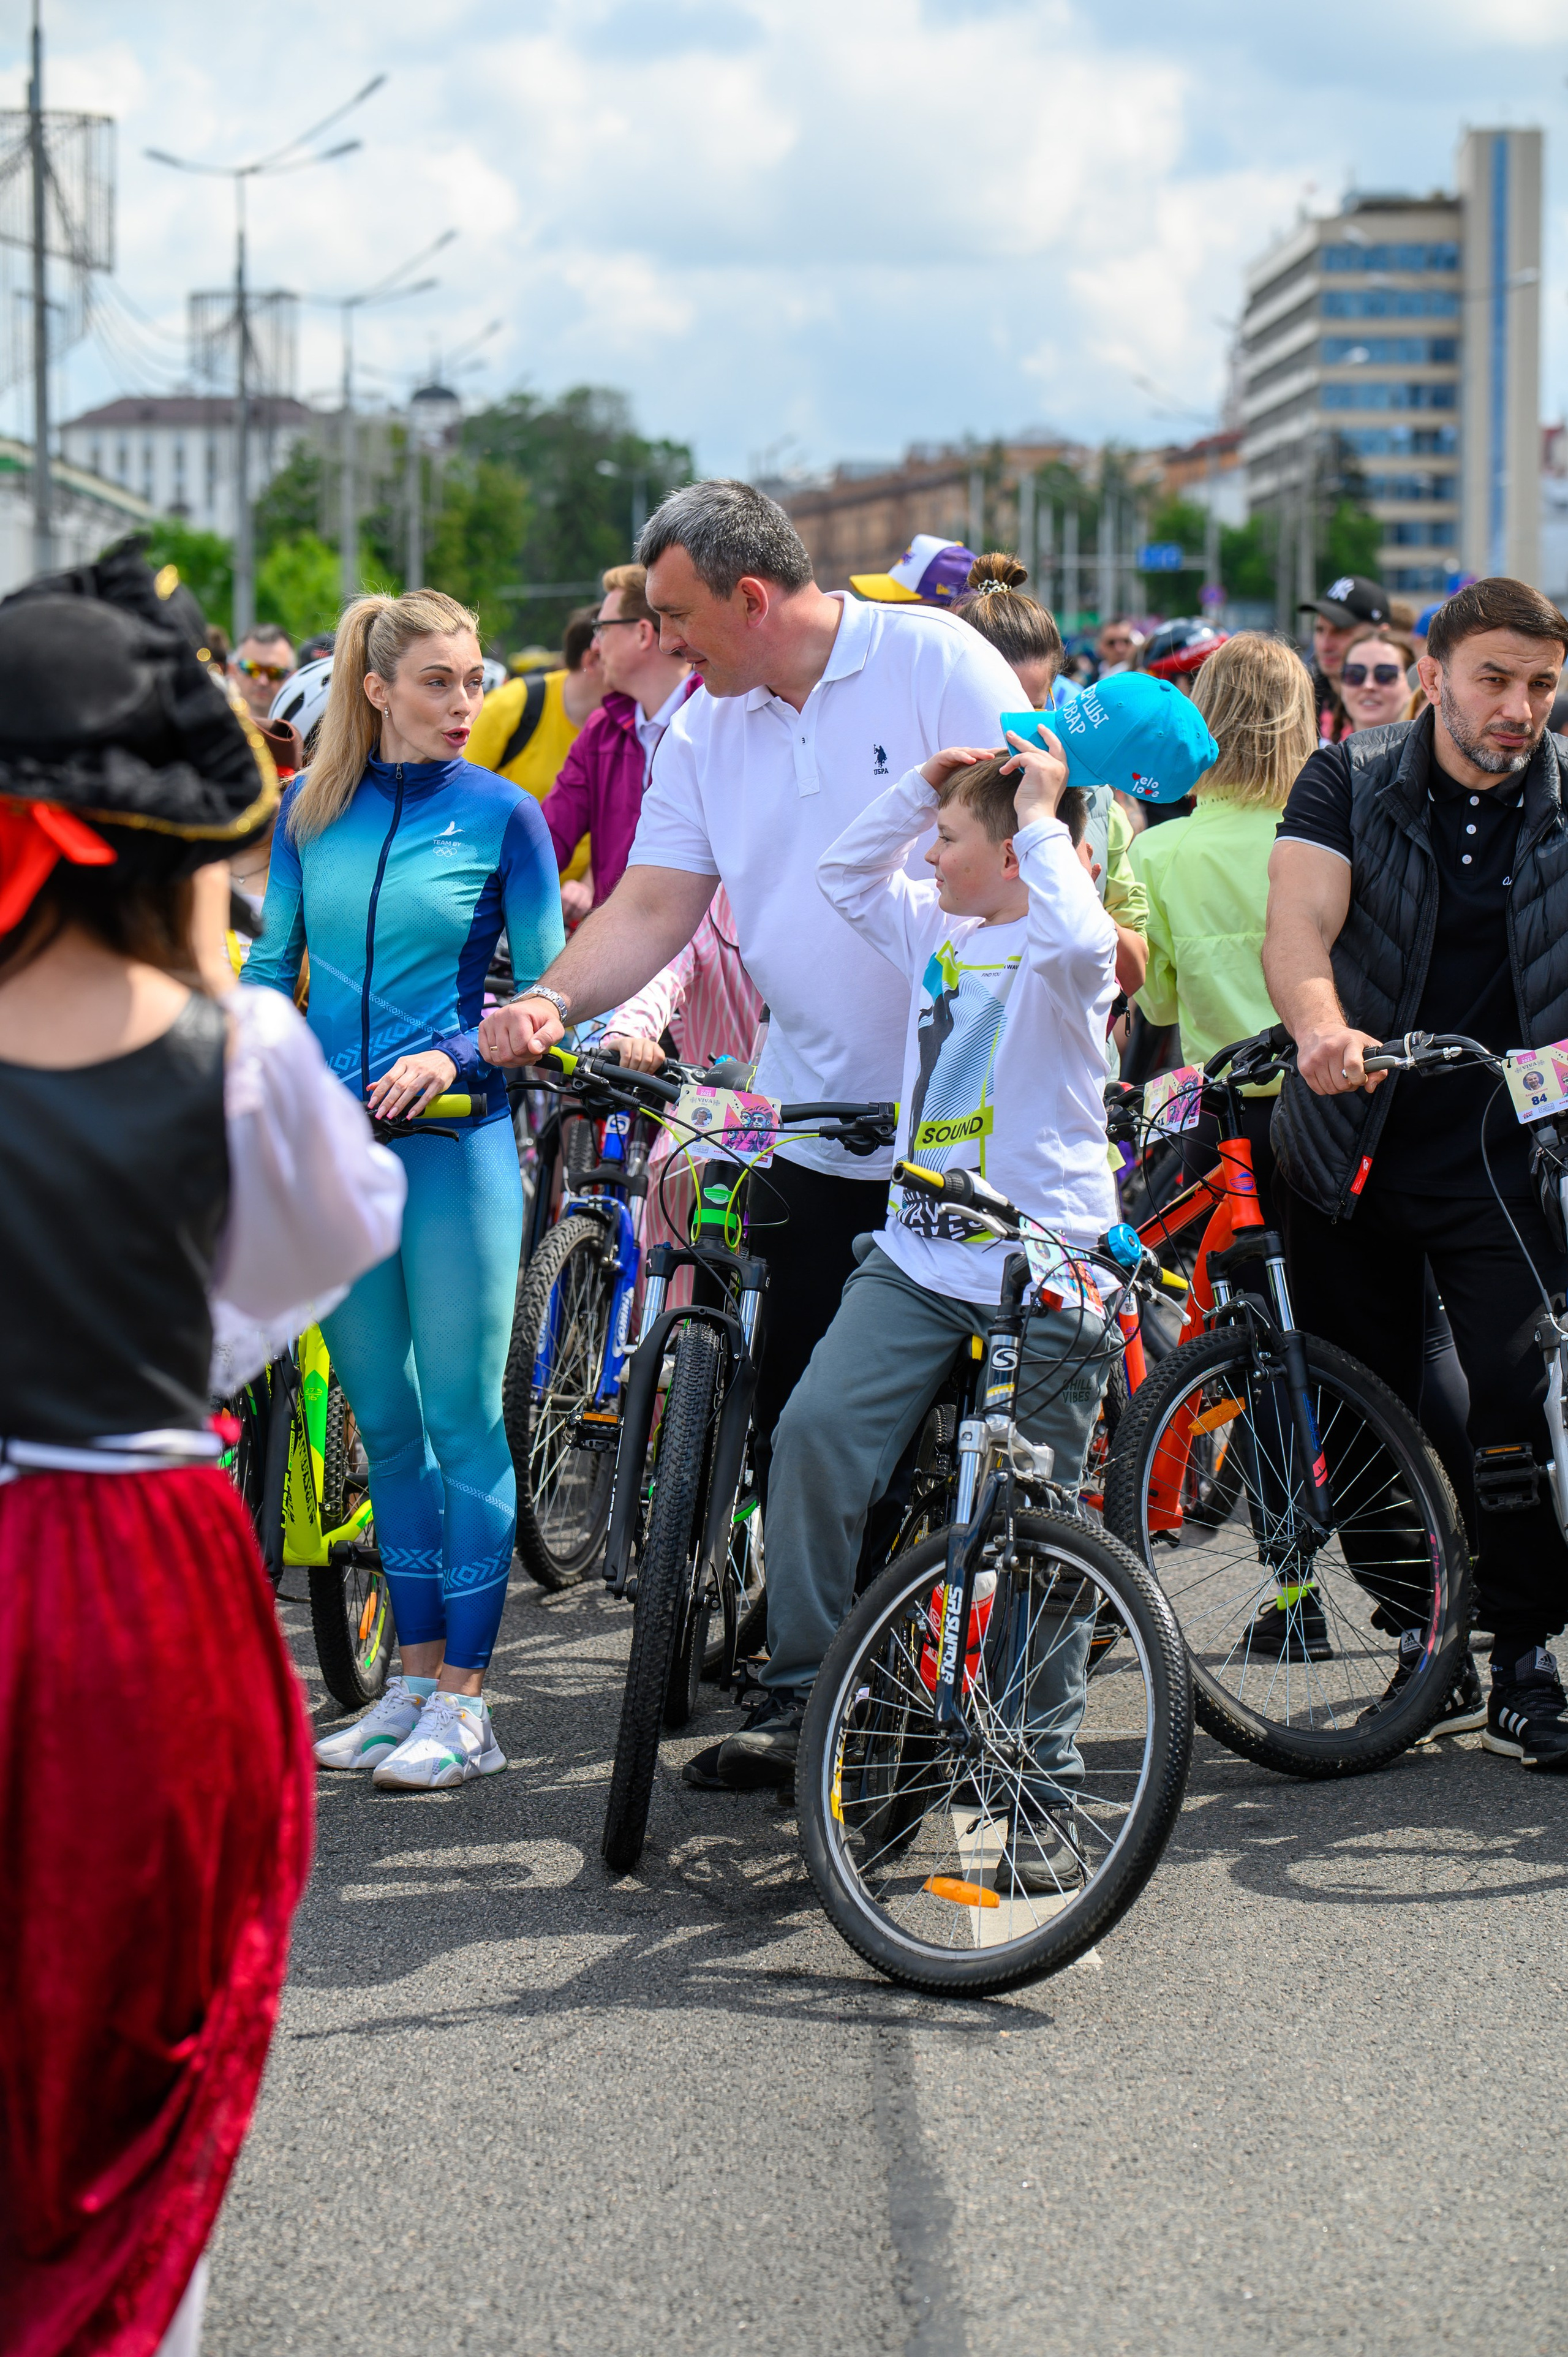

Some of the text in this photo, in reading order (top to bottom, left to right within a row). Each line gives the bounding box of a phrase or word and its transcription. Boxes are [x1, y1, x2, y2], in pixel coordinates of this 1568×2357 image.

[1531, 1093, 1548, 1106] 84
[922, 1116, 984, 1144] SOUND
[1063, 1378, 1091, 1390] CHILL
[1062, 1390, 1091, 1403] VIBES
